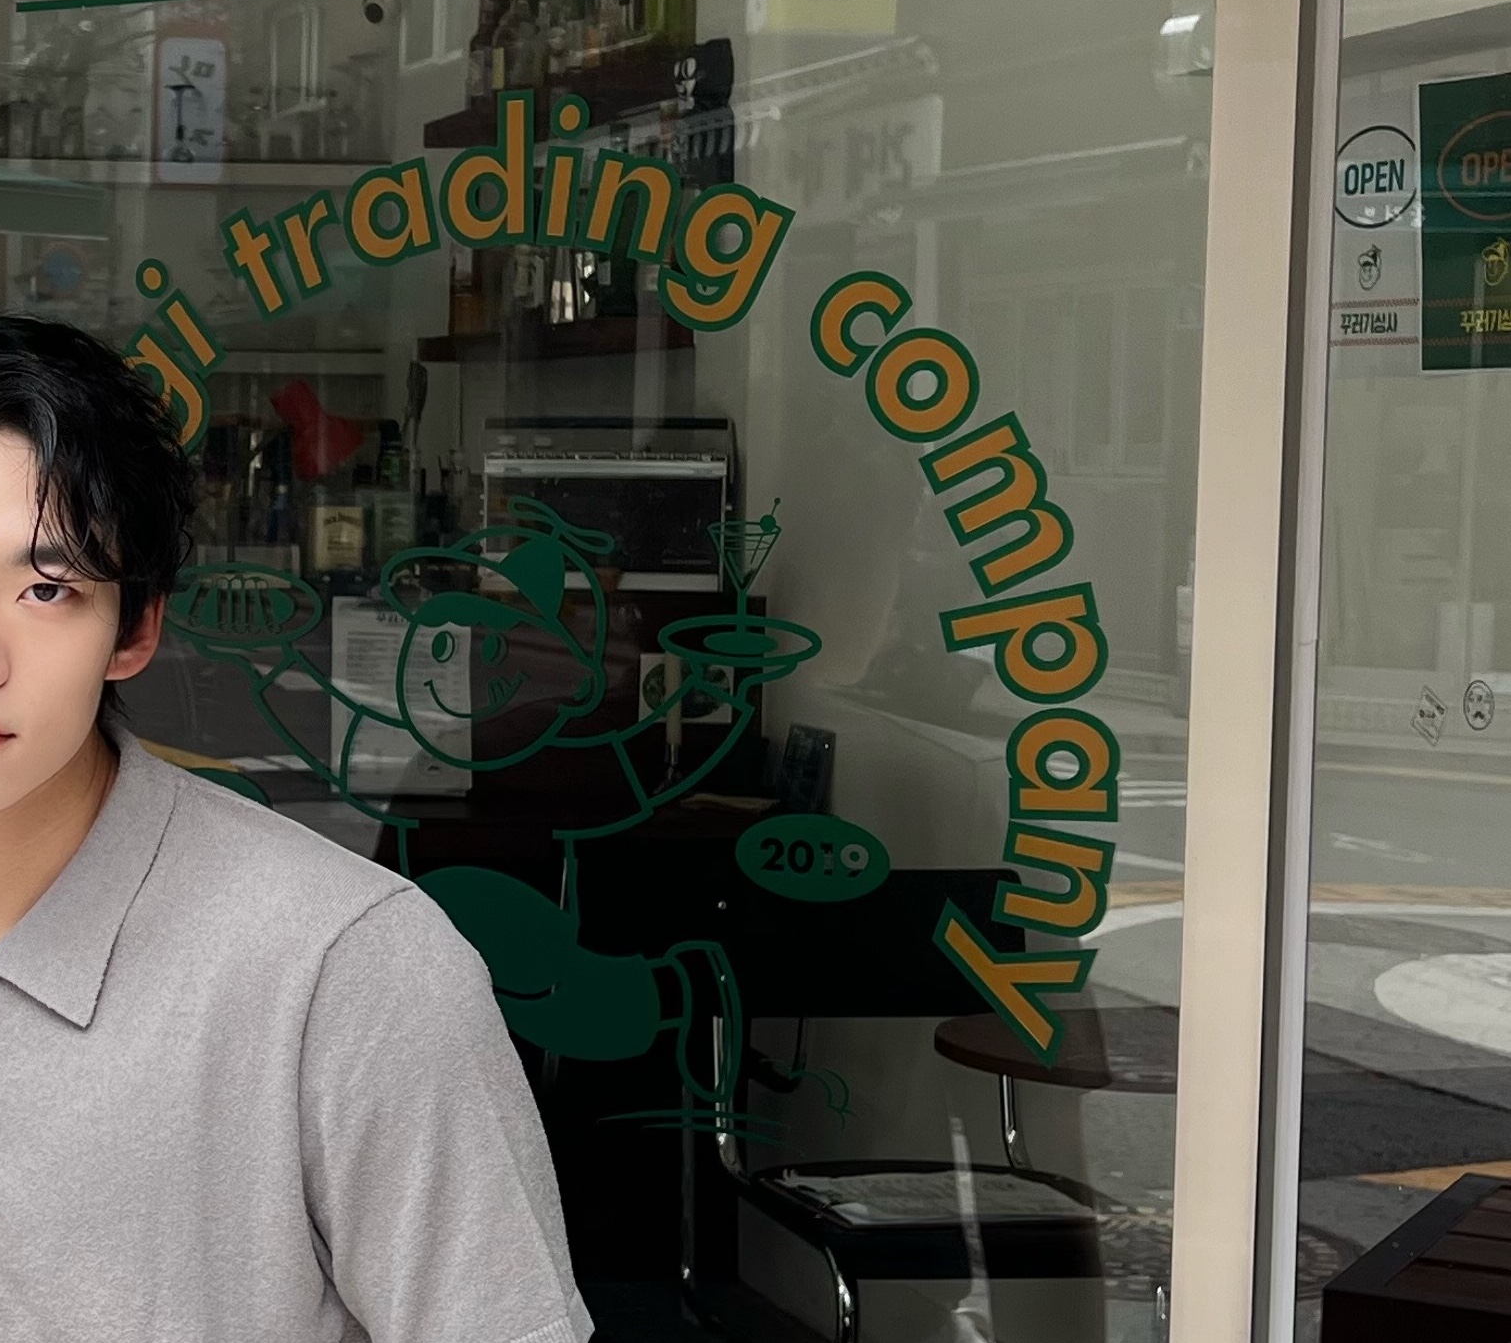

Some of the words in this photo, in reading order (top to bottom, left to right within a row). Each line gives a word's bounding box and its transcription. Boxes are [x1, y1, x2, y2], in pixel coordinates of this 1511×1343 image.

[1344, 158, 1405, 195] OPEN
[1462, 148, 1511, 186] OPE
[221, 89, 797, 331] trading
[809, 268, 1122, 1068] company
[759, 837, 870, 879] 2019
